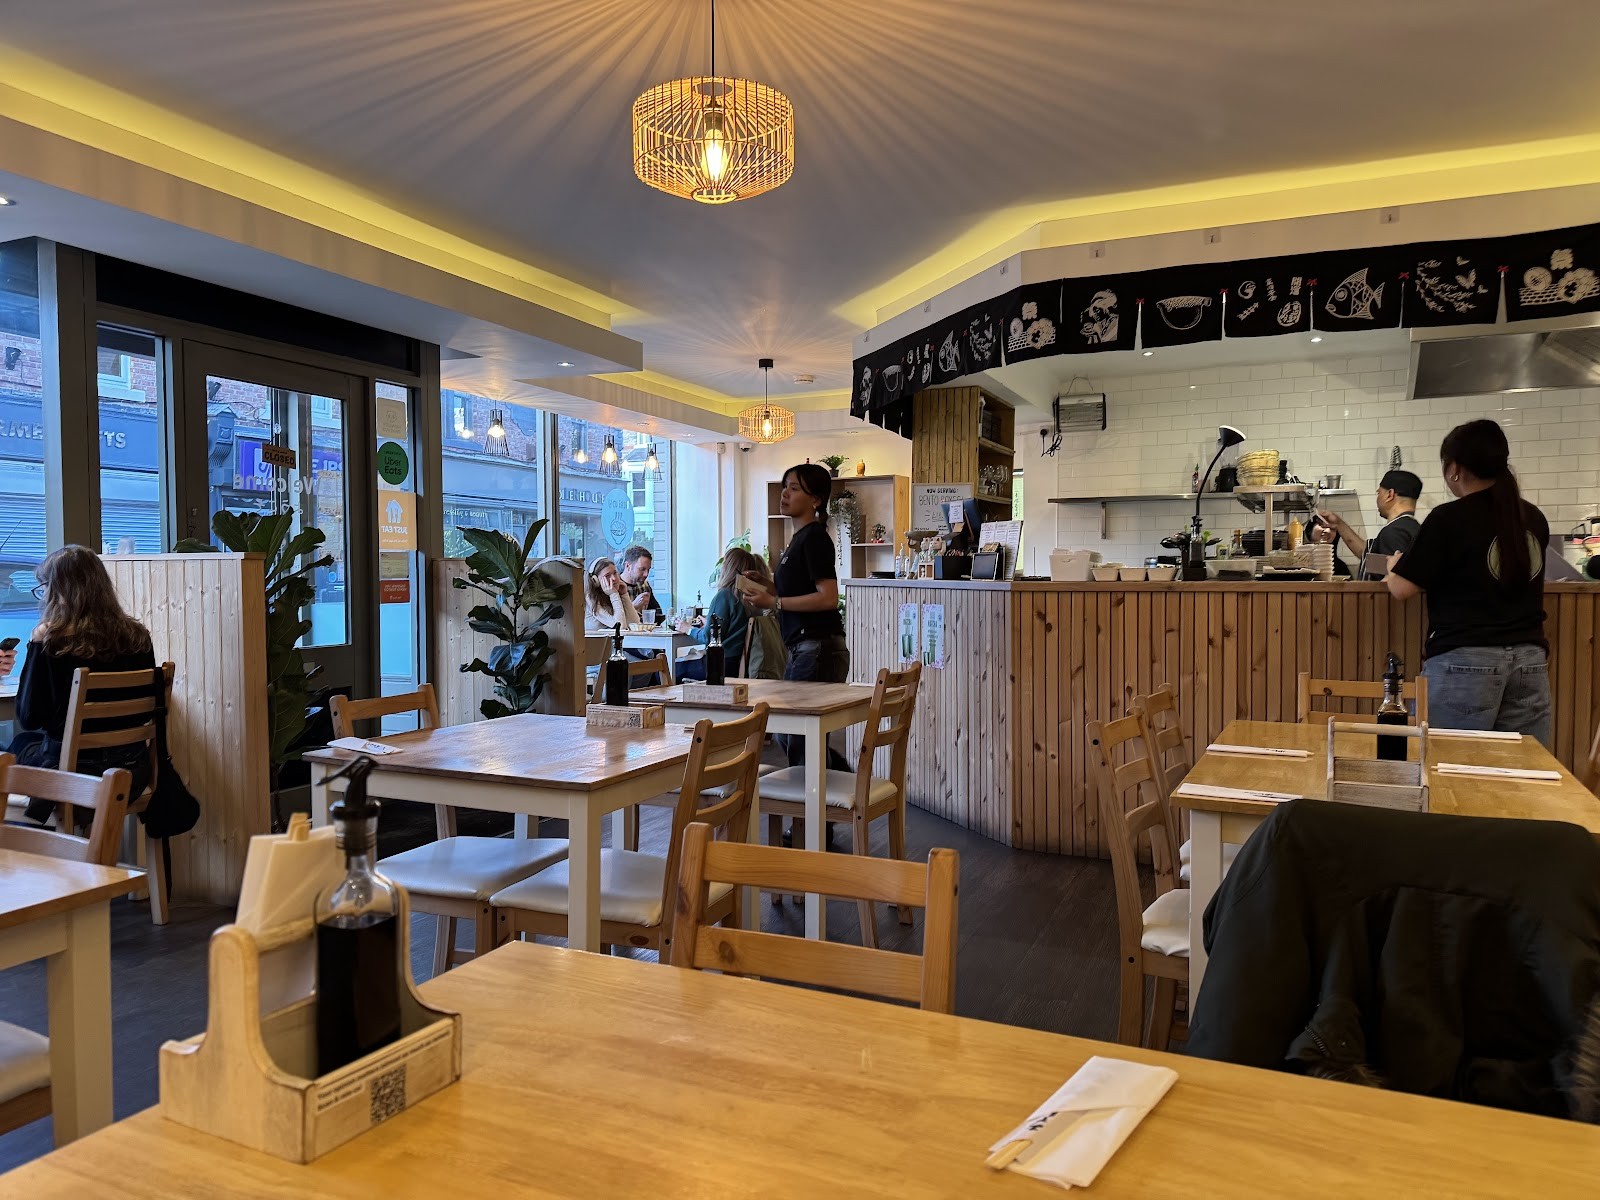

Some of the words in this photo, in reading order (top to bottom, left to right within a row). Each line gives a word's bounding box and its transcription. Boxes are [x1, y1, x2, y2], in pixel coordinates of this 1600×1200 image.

[264, 451, 295, 465] CLOSED
[384, 456, 401, 466] Uber
[384, 465, 402, 475] Eats
[919, 495, 939, 506] BENTO
